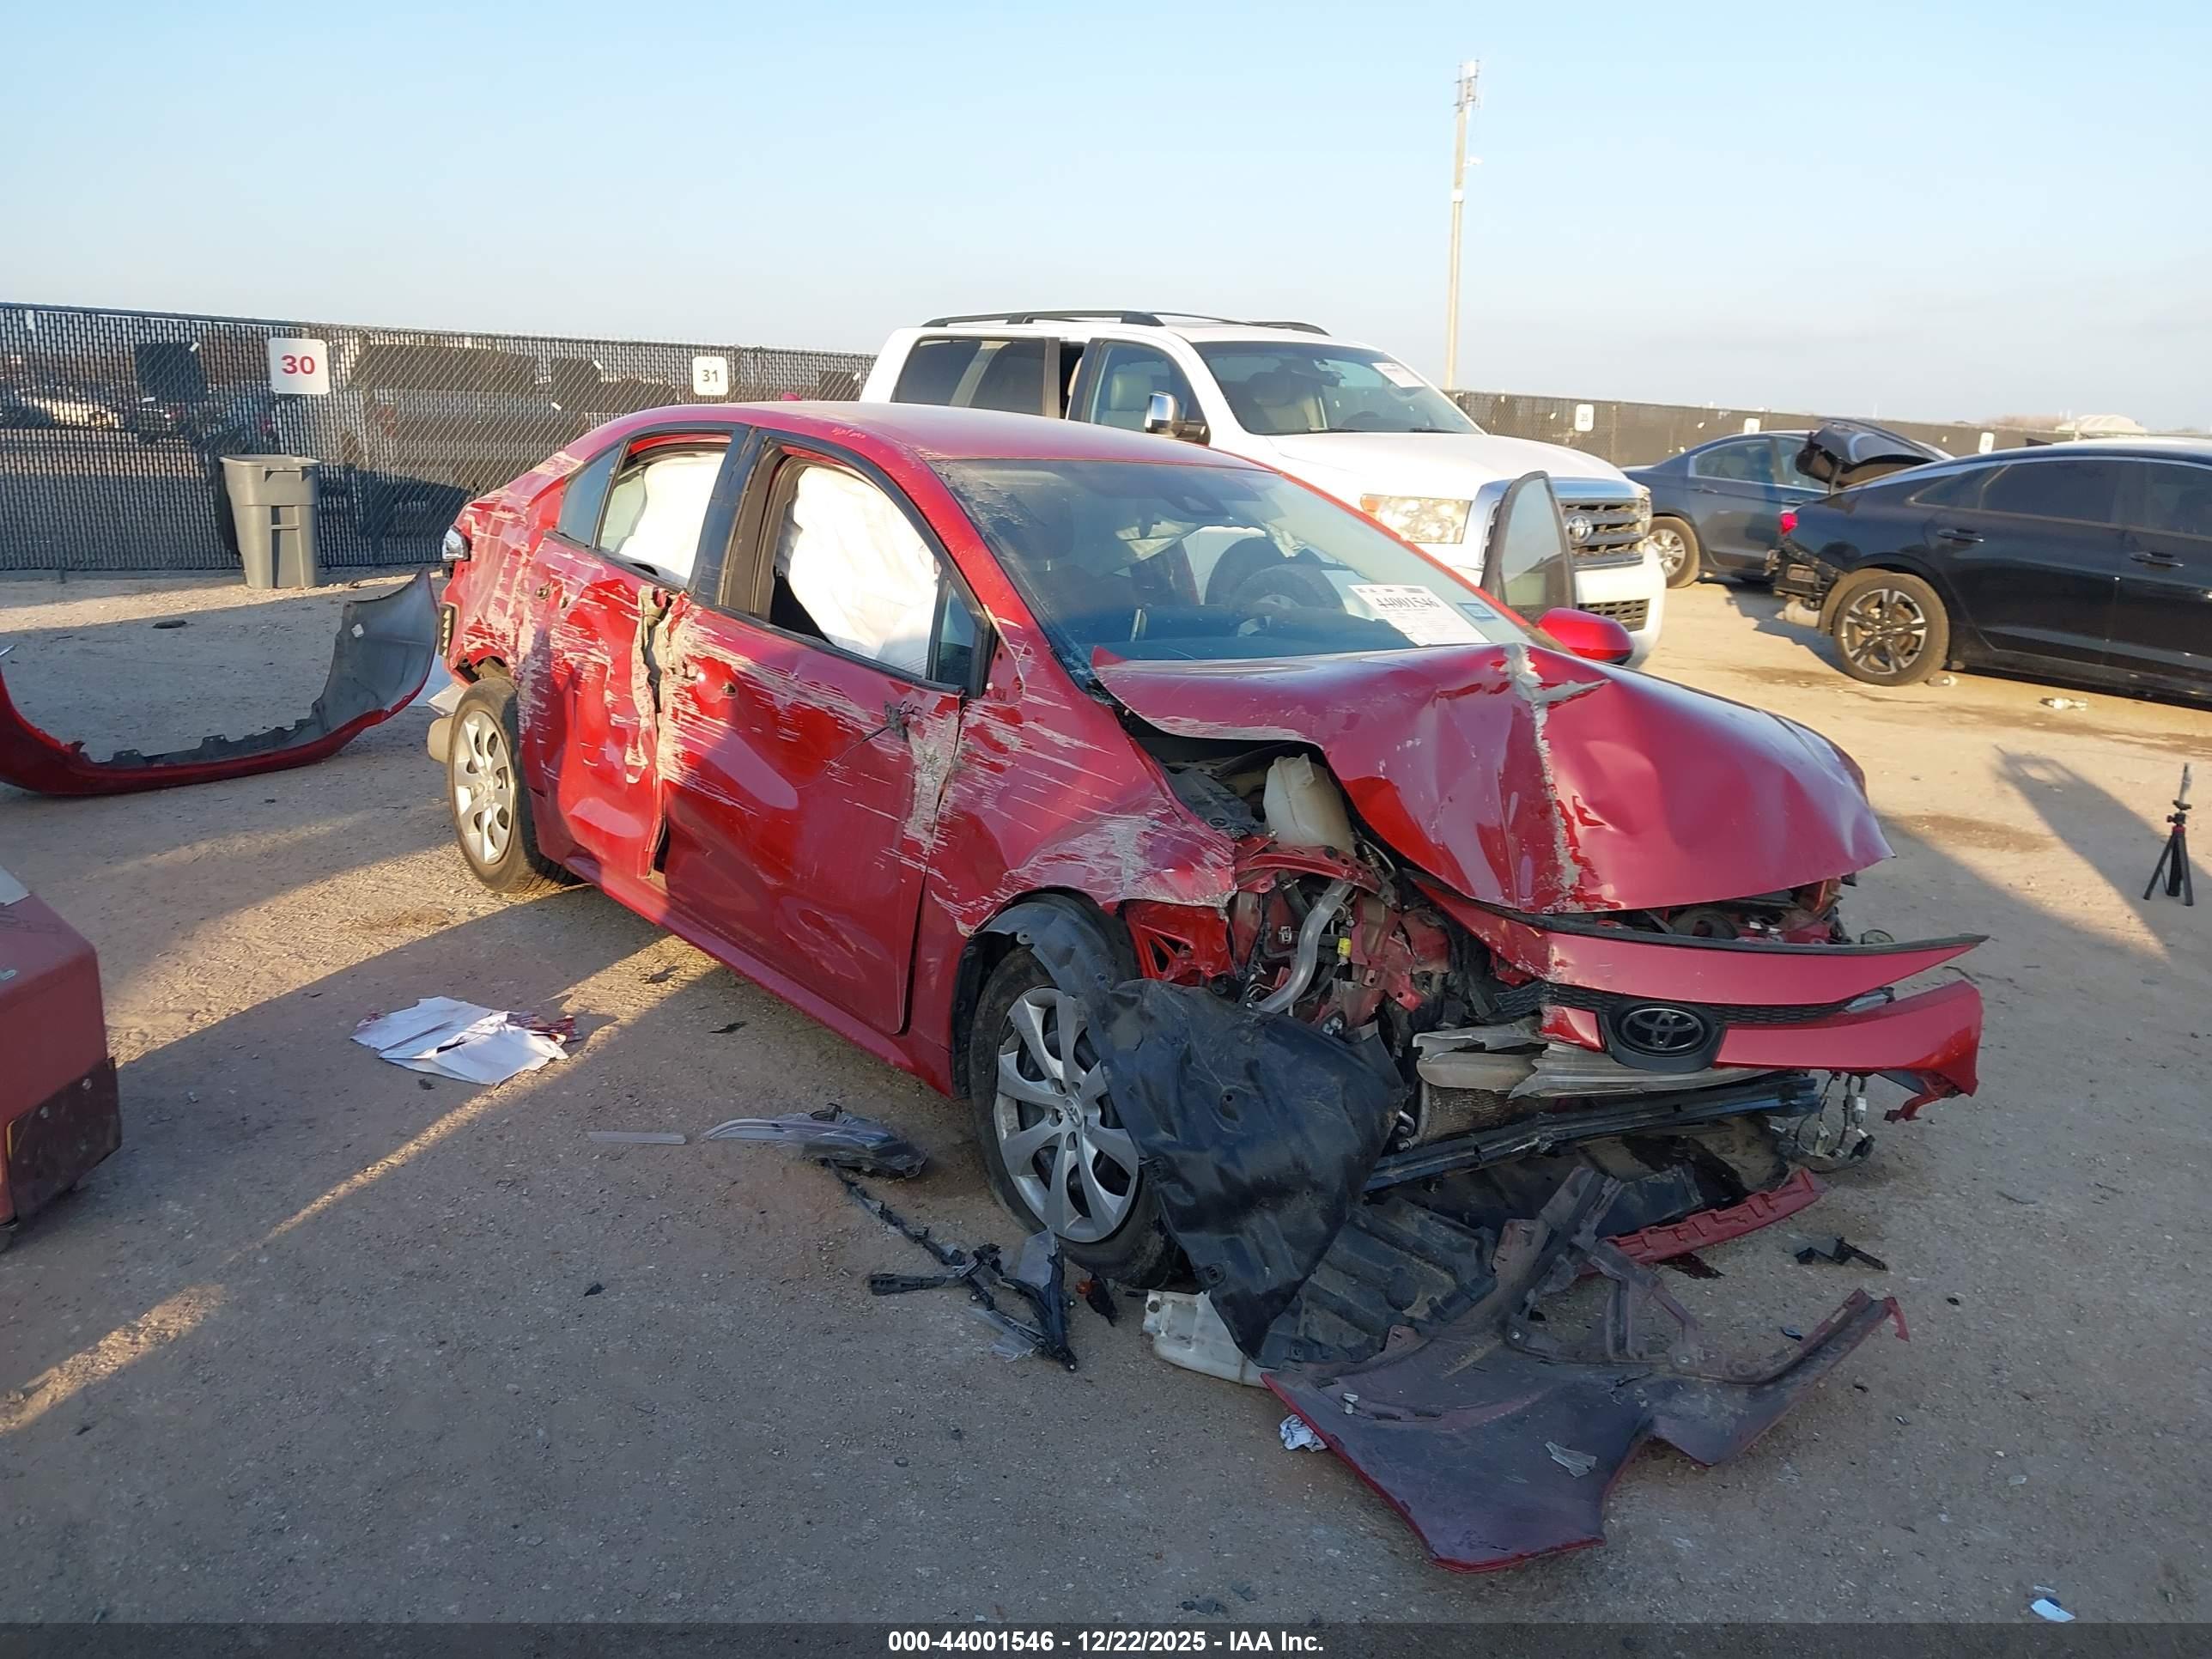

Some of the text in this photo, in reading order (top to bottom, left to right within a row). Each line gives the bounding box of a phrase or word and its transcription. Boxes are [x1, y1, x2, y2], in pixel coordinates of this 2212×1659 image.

[281, 355, 315, 375] 30
[702, 369, 718, 382] 31
[1376, 597, 1441, 608] 44001546
